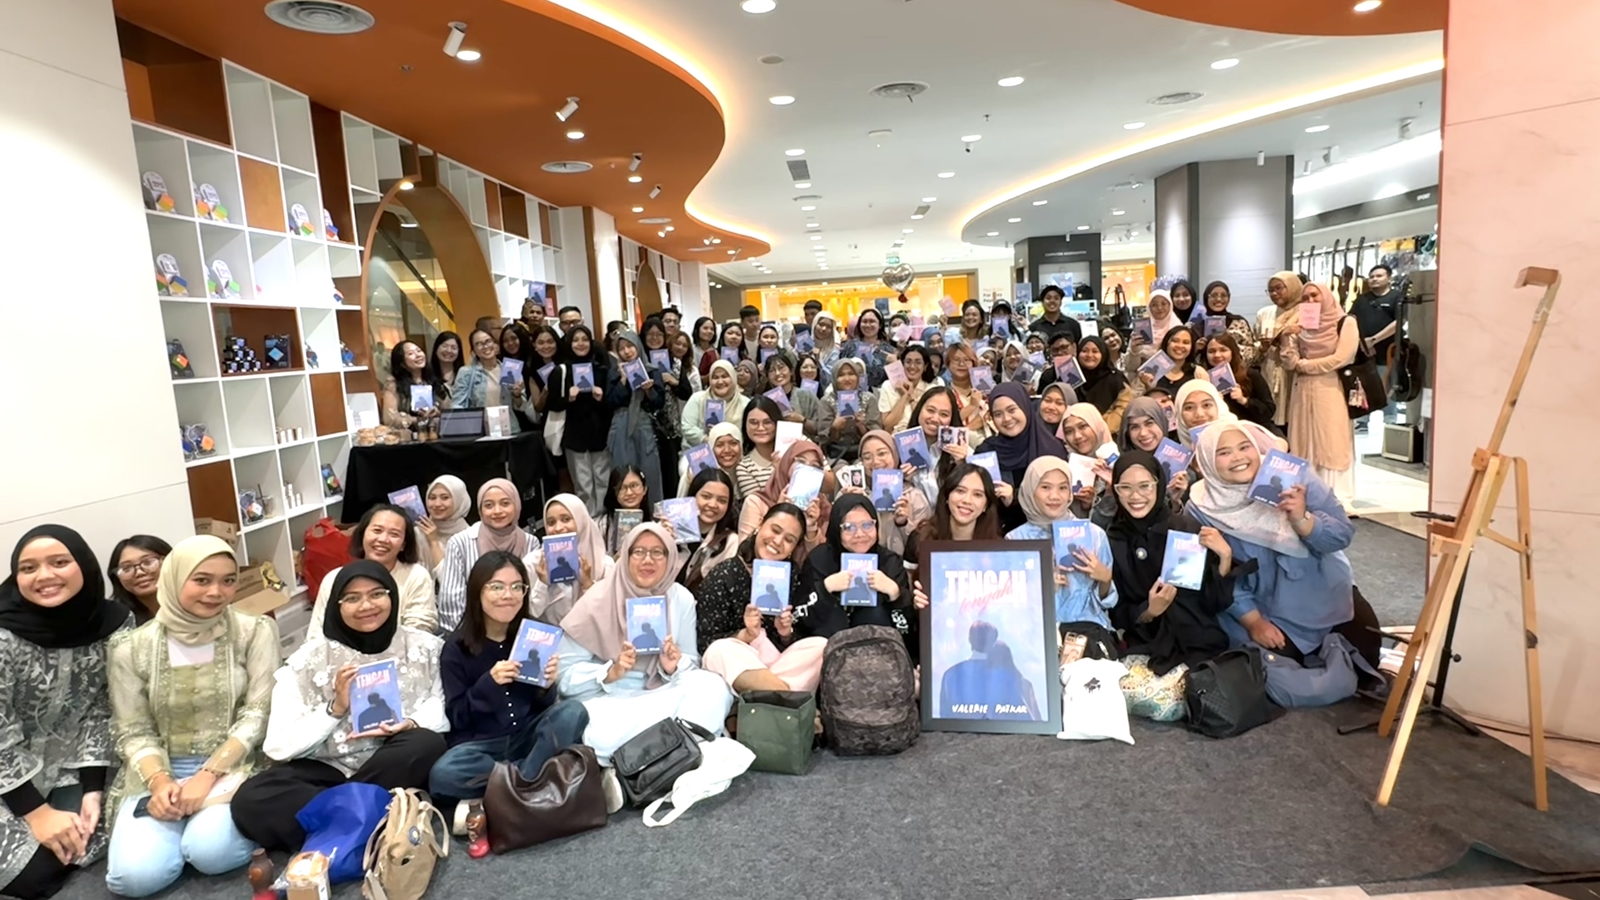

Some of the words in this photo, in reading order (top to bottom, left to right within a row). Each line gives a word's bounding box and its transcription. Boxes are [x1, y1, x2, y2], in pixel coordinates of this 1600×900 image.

[1269, 455, 1301, 476] TENGAH
[945, 570, 1027, 607] TENGAH
[356, 669, 391, 689] TENGAH
[952, 703, 988, 714] VALERIE
[995, 703, 1027, 714] PATKAR
